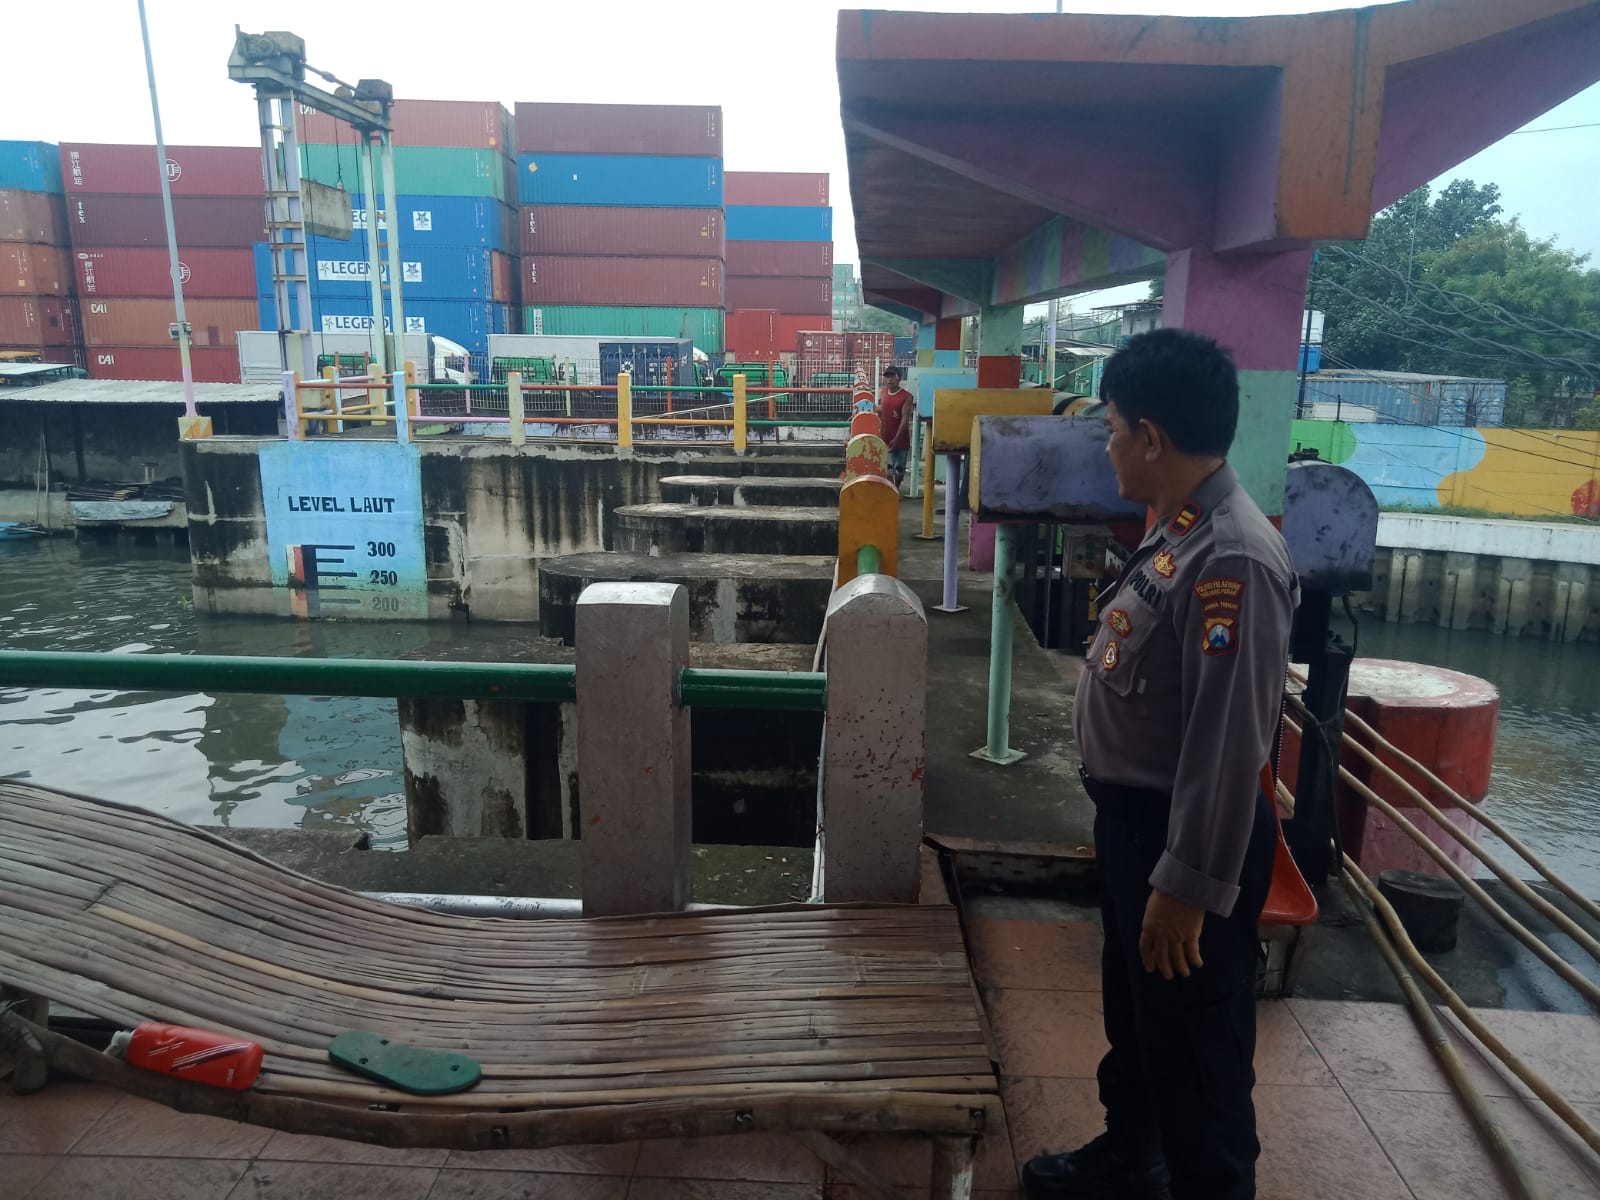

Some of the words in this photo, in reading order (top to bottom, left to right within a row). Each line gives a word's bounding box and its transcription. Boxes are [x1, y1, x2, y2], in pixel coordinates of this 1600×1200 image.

[288, 496, 345, 512] LEVEL
[350, 497, 395, 513] LAUT
[367, 541, 396, 557] 300
[370, 570, 398, 586] 250
[372, 597, 399, 612] 200
